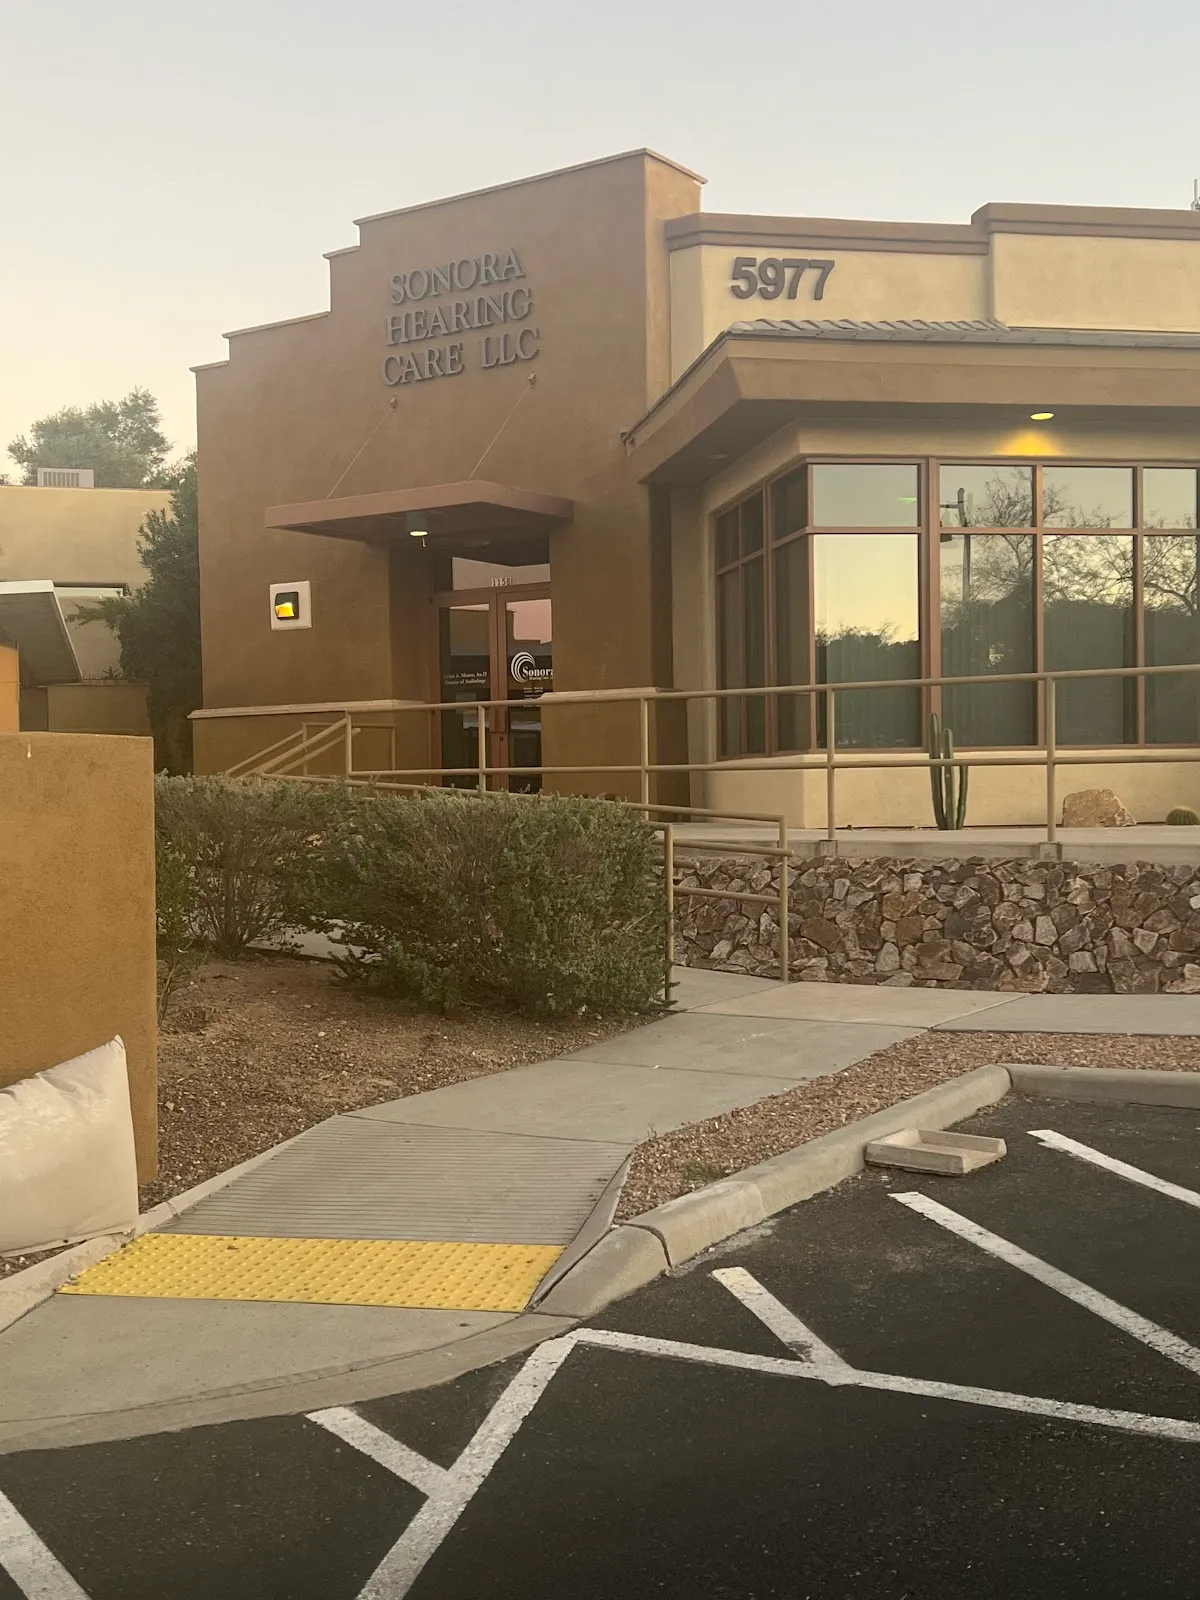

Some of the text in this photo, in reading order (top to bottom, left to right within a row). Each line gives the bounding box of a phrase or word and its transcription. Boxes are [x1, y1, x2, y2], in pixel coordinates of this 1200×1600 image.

[390, 248, 526, 305] SONORA
[730, 257, 835, 300] 5977
[385, 288, 533, 346] HEARING
[381, 328, 540, 386] CARE LLC
